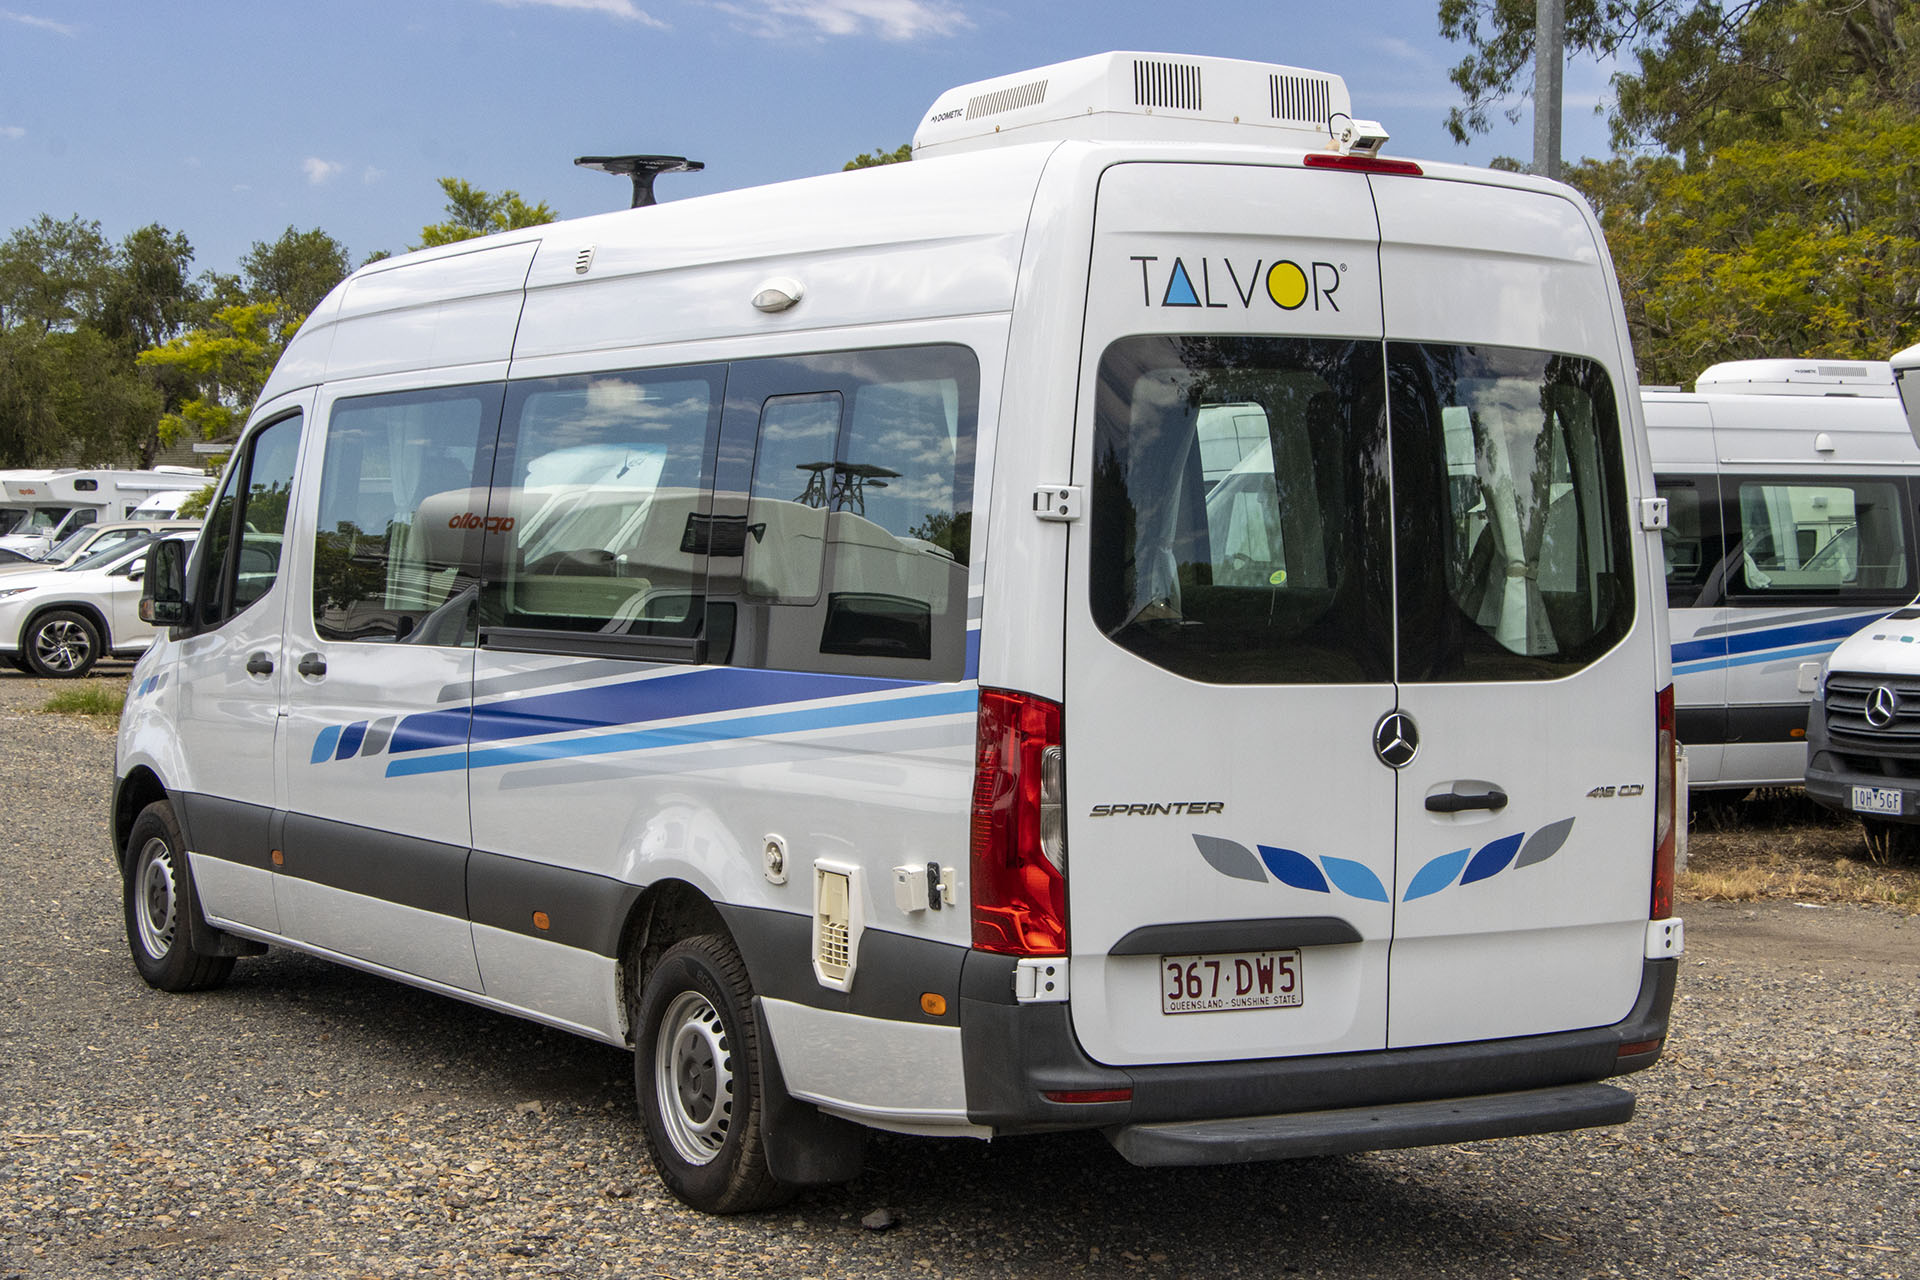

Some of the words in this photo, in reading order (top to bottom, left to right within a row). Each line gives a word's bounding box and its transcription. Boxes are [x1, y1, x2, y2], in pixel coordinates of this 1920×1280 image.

[937, 108, 963, 122] DOMETIC
[1617, 784, 1645, 797] CDI
[1880, 792, 1900, 809] 5GF
[1089, 801, 1225, 817] SPRINTER
[1170, 1000, 1223, 1011] QUEENSLAND
[1231, 996, 1270, 1007] SUNSHINE
[1273, 994, 1296, 1005] STATE
